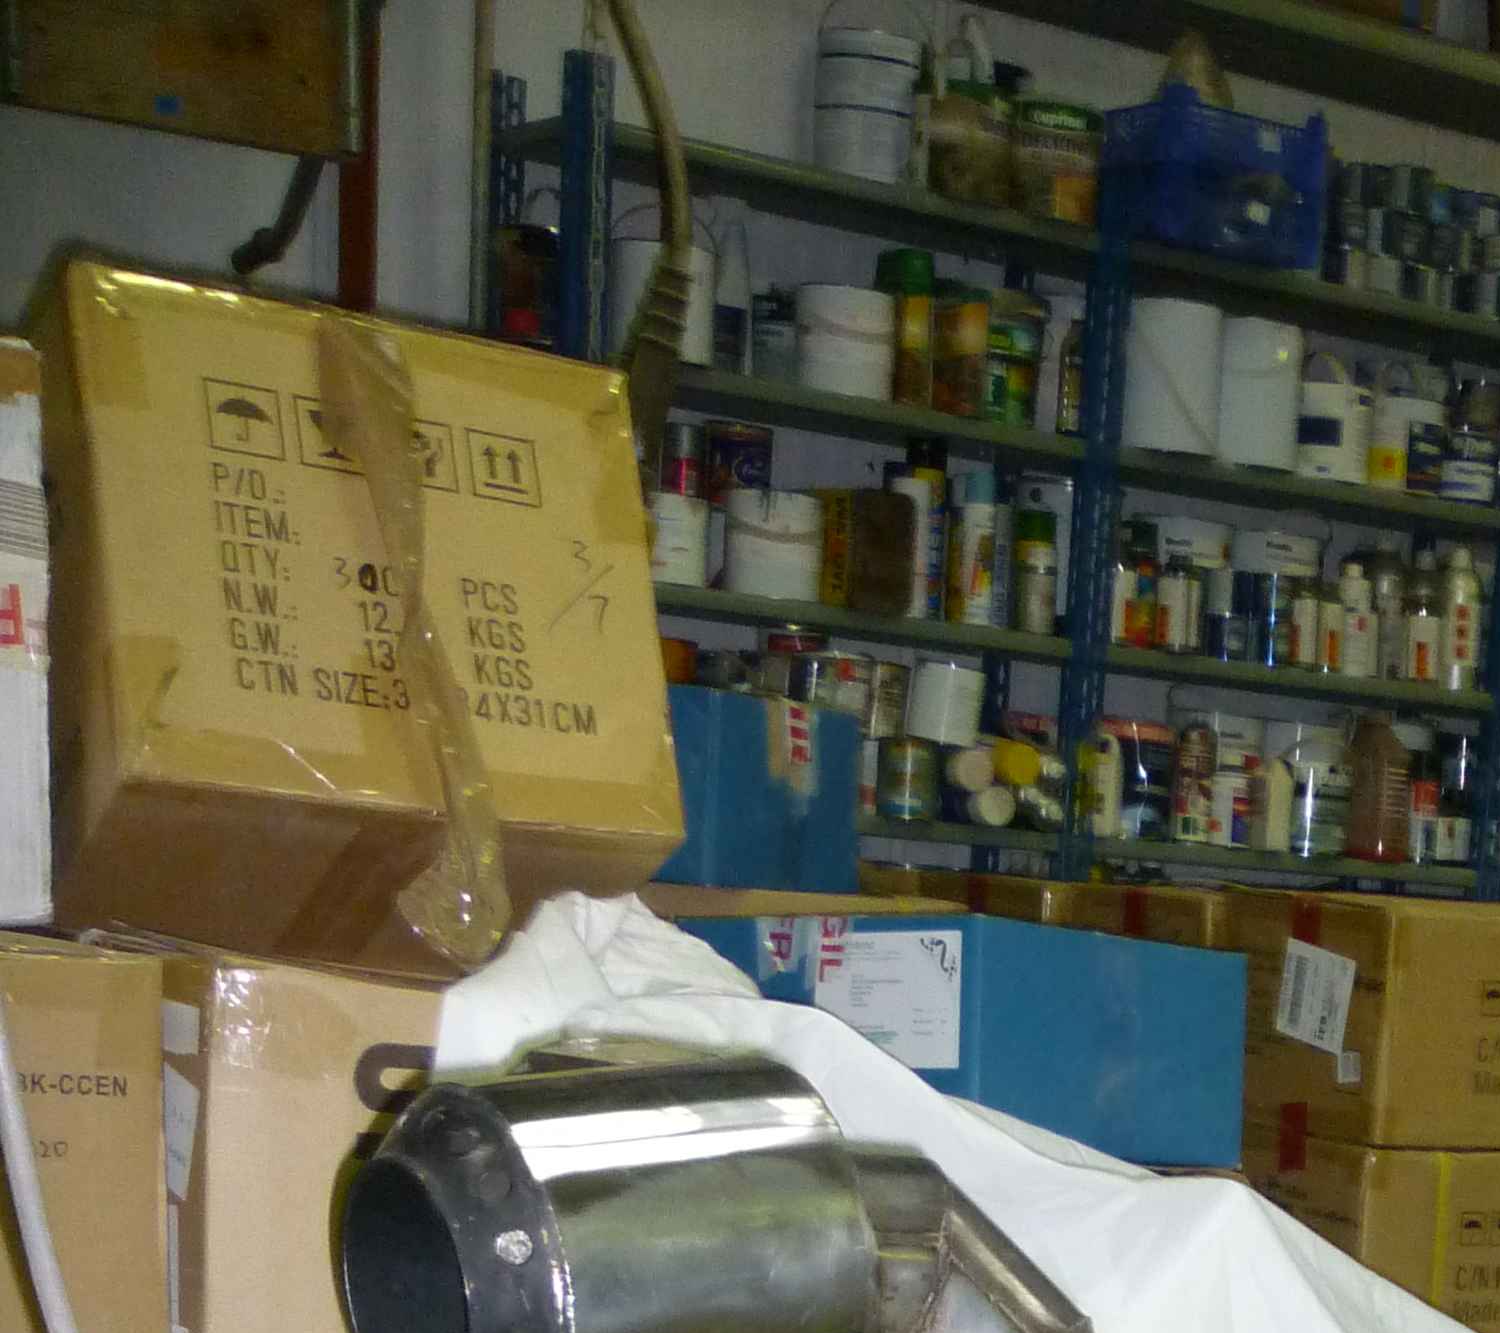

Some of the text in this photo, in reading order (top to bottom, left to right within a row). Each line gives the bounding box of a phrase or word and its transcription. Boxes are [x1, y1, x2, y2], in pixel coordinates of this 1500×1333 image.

[213, 499, 301, 545] ITEM:
[460, 577, 519, 616] PCS
[467, 616, 527, 654] KGS
[237, 656, 300, 696] CTN
[473, 654, 534, 691] KGS
